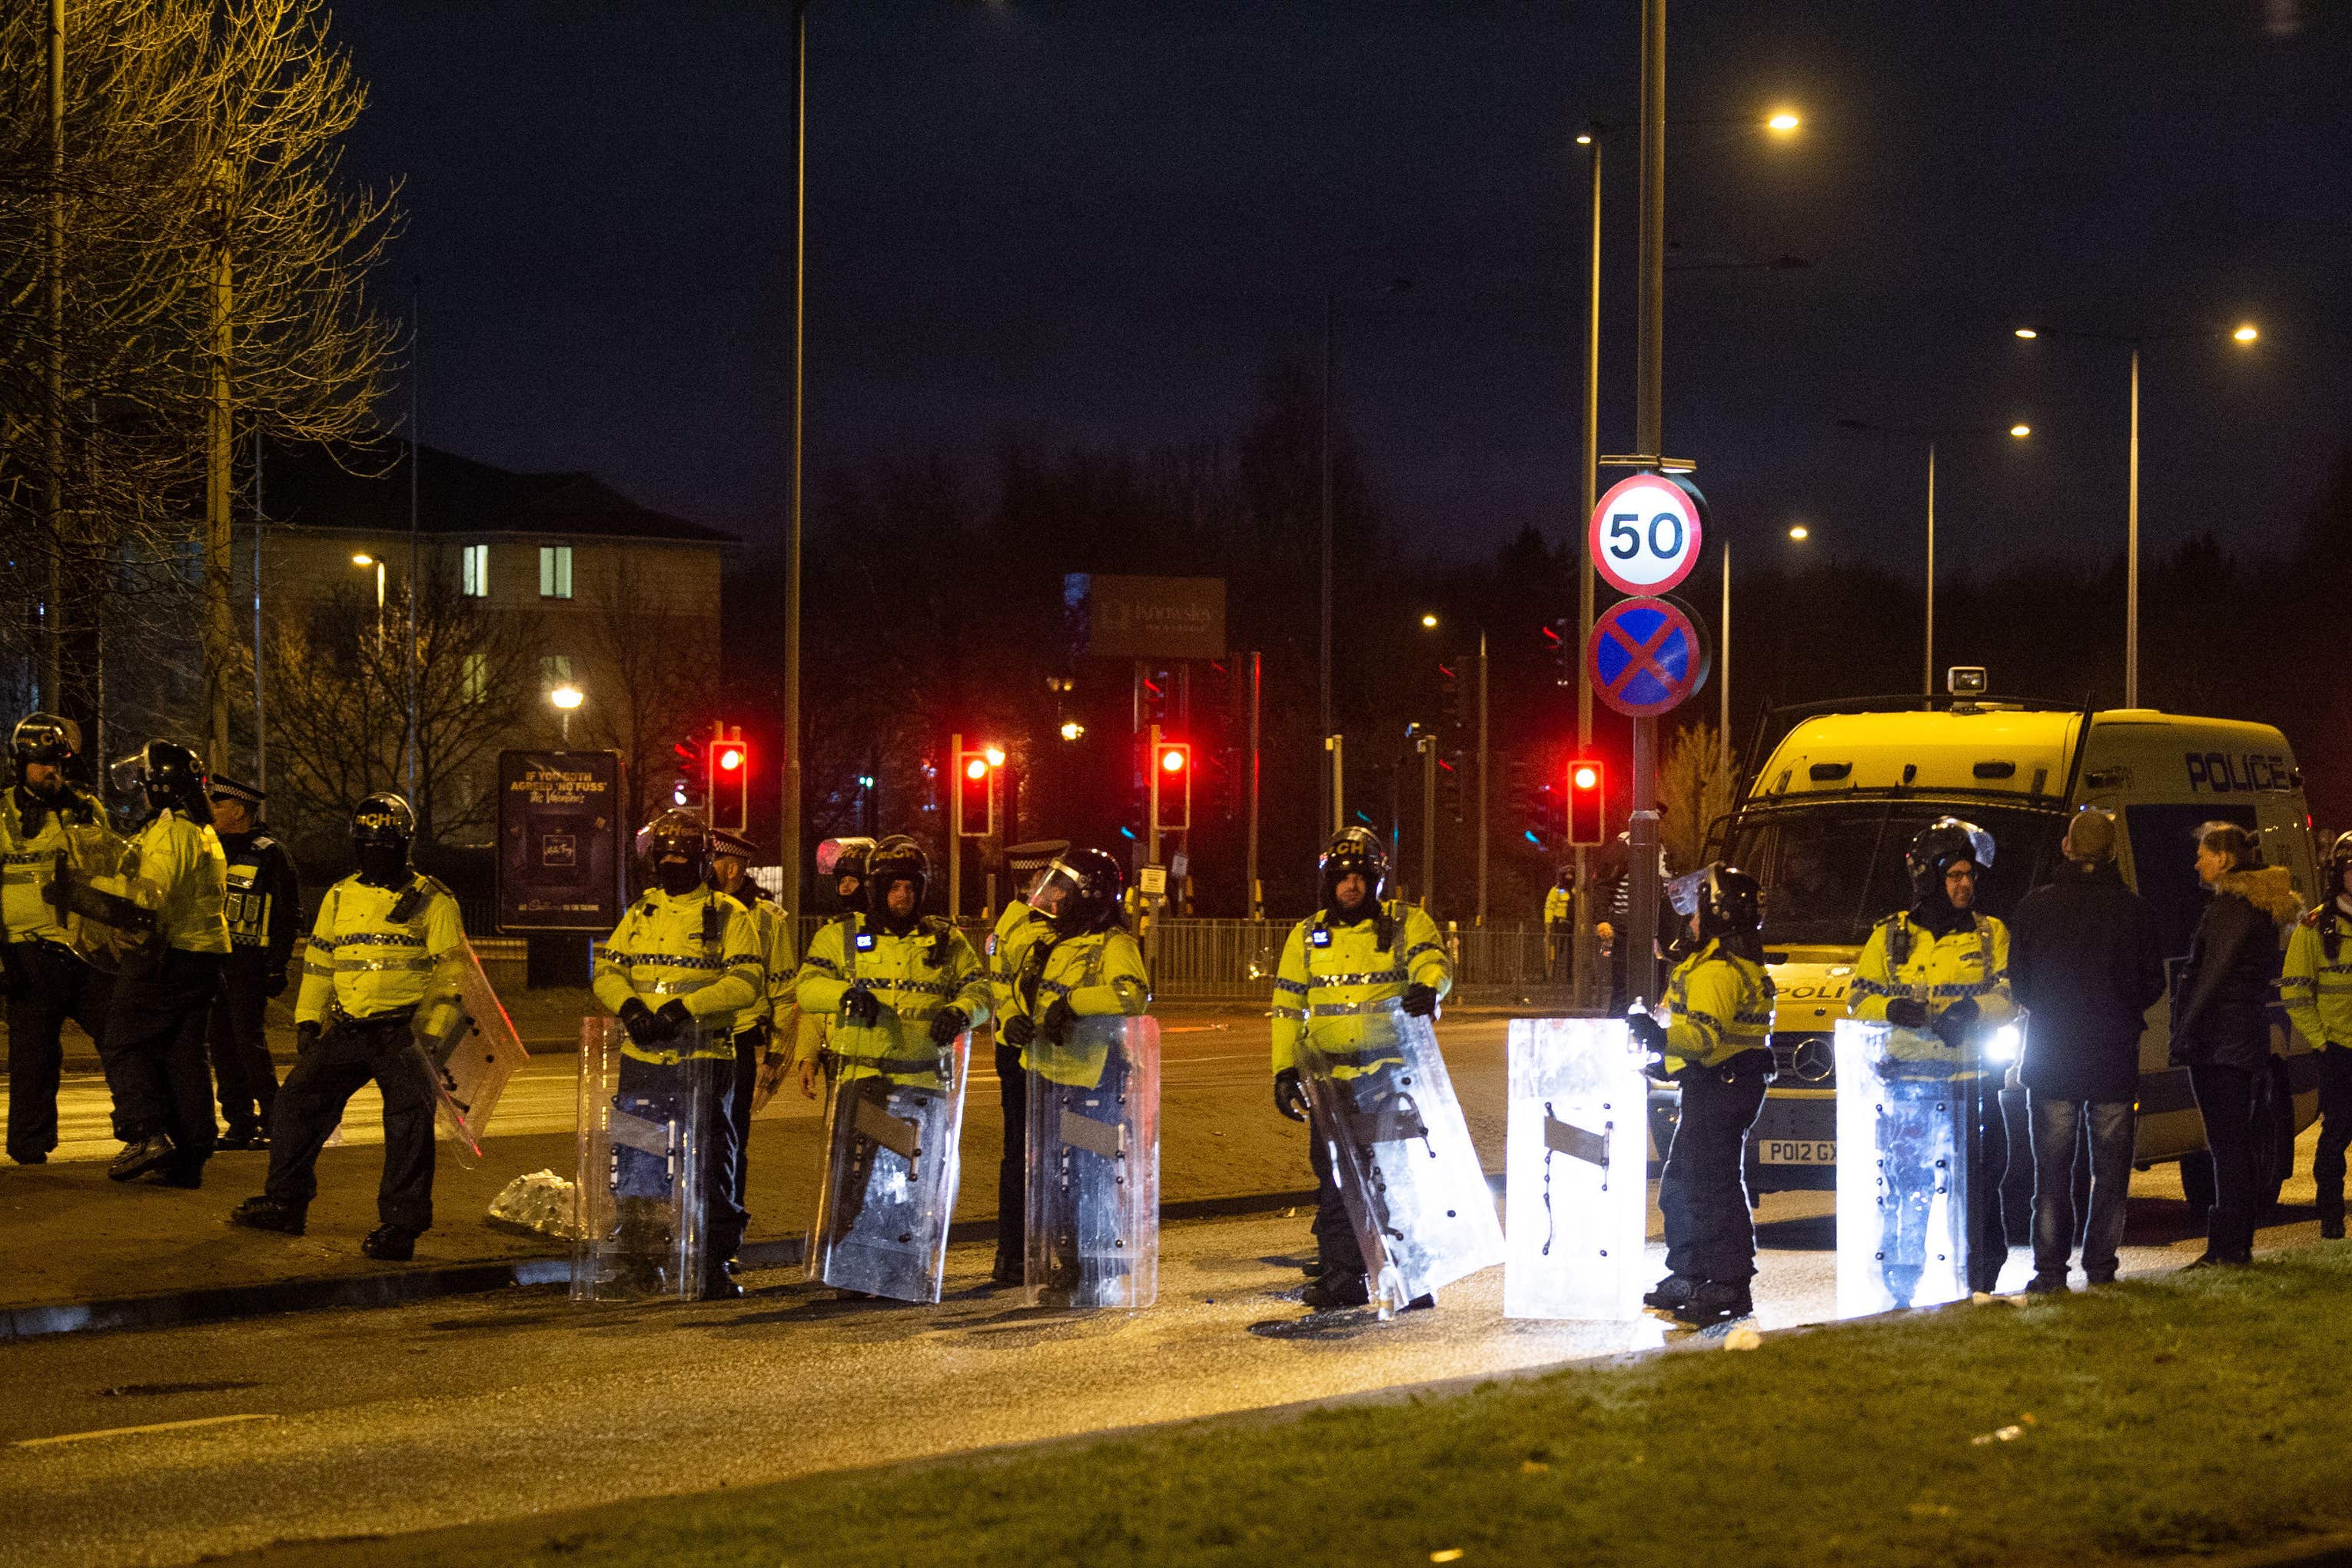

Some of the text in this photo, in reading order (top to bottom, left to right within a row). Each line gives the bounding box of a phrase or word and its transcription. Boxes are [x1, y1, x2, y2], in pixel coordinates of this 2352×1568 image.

[1610, 513, 1683, 559] 50
[2185, 752, 2290, 794] POLICE
[1337, 841, 1365, 855] CH
[1776, 986, 1845, 998] POLI
[1770, 1143, 1837, 1161] PO12 GX
